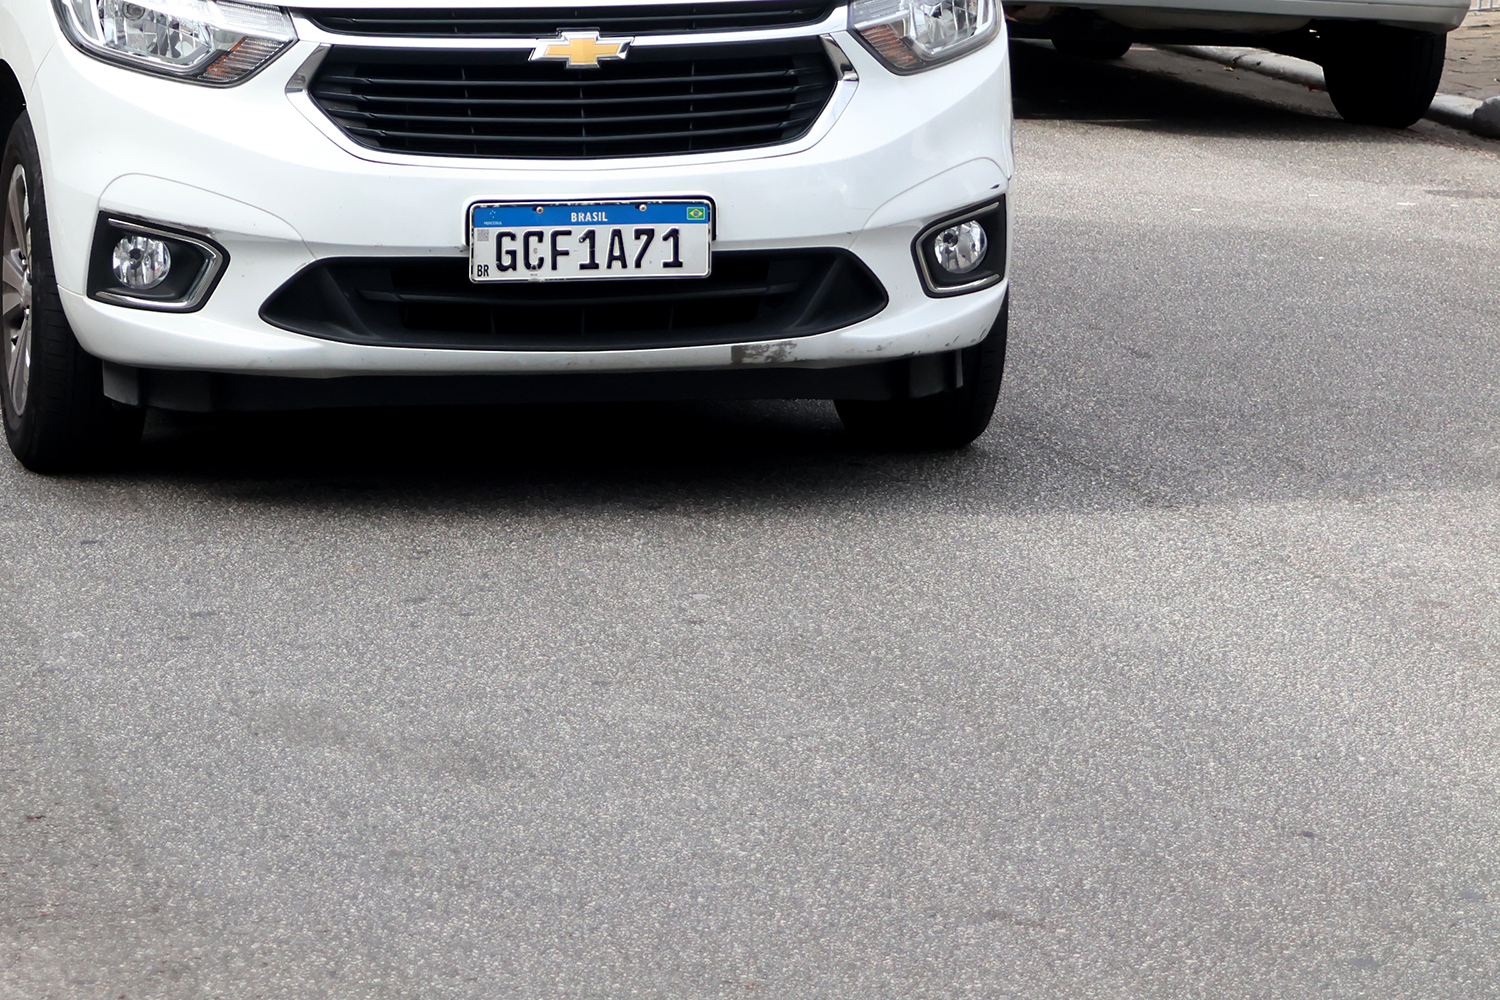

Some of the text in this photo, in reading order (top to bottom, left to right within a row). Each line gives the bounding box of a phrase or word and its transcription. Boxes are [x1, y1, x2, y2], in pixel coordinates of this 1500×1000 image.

[570, 211, 608, 223] BRASIL
[495, 227, 684, 272] GCF1A71
[477, 264, 490, 278] BR
